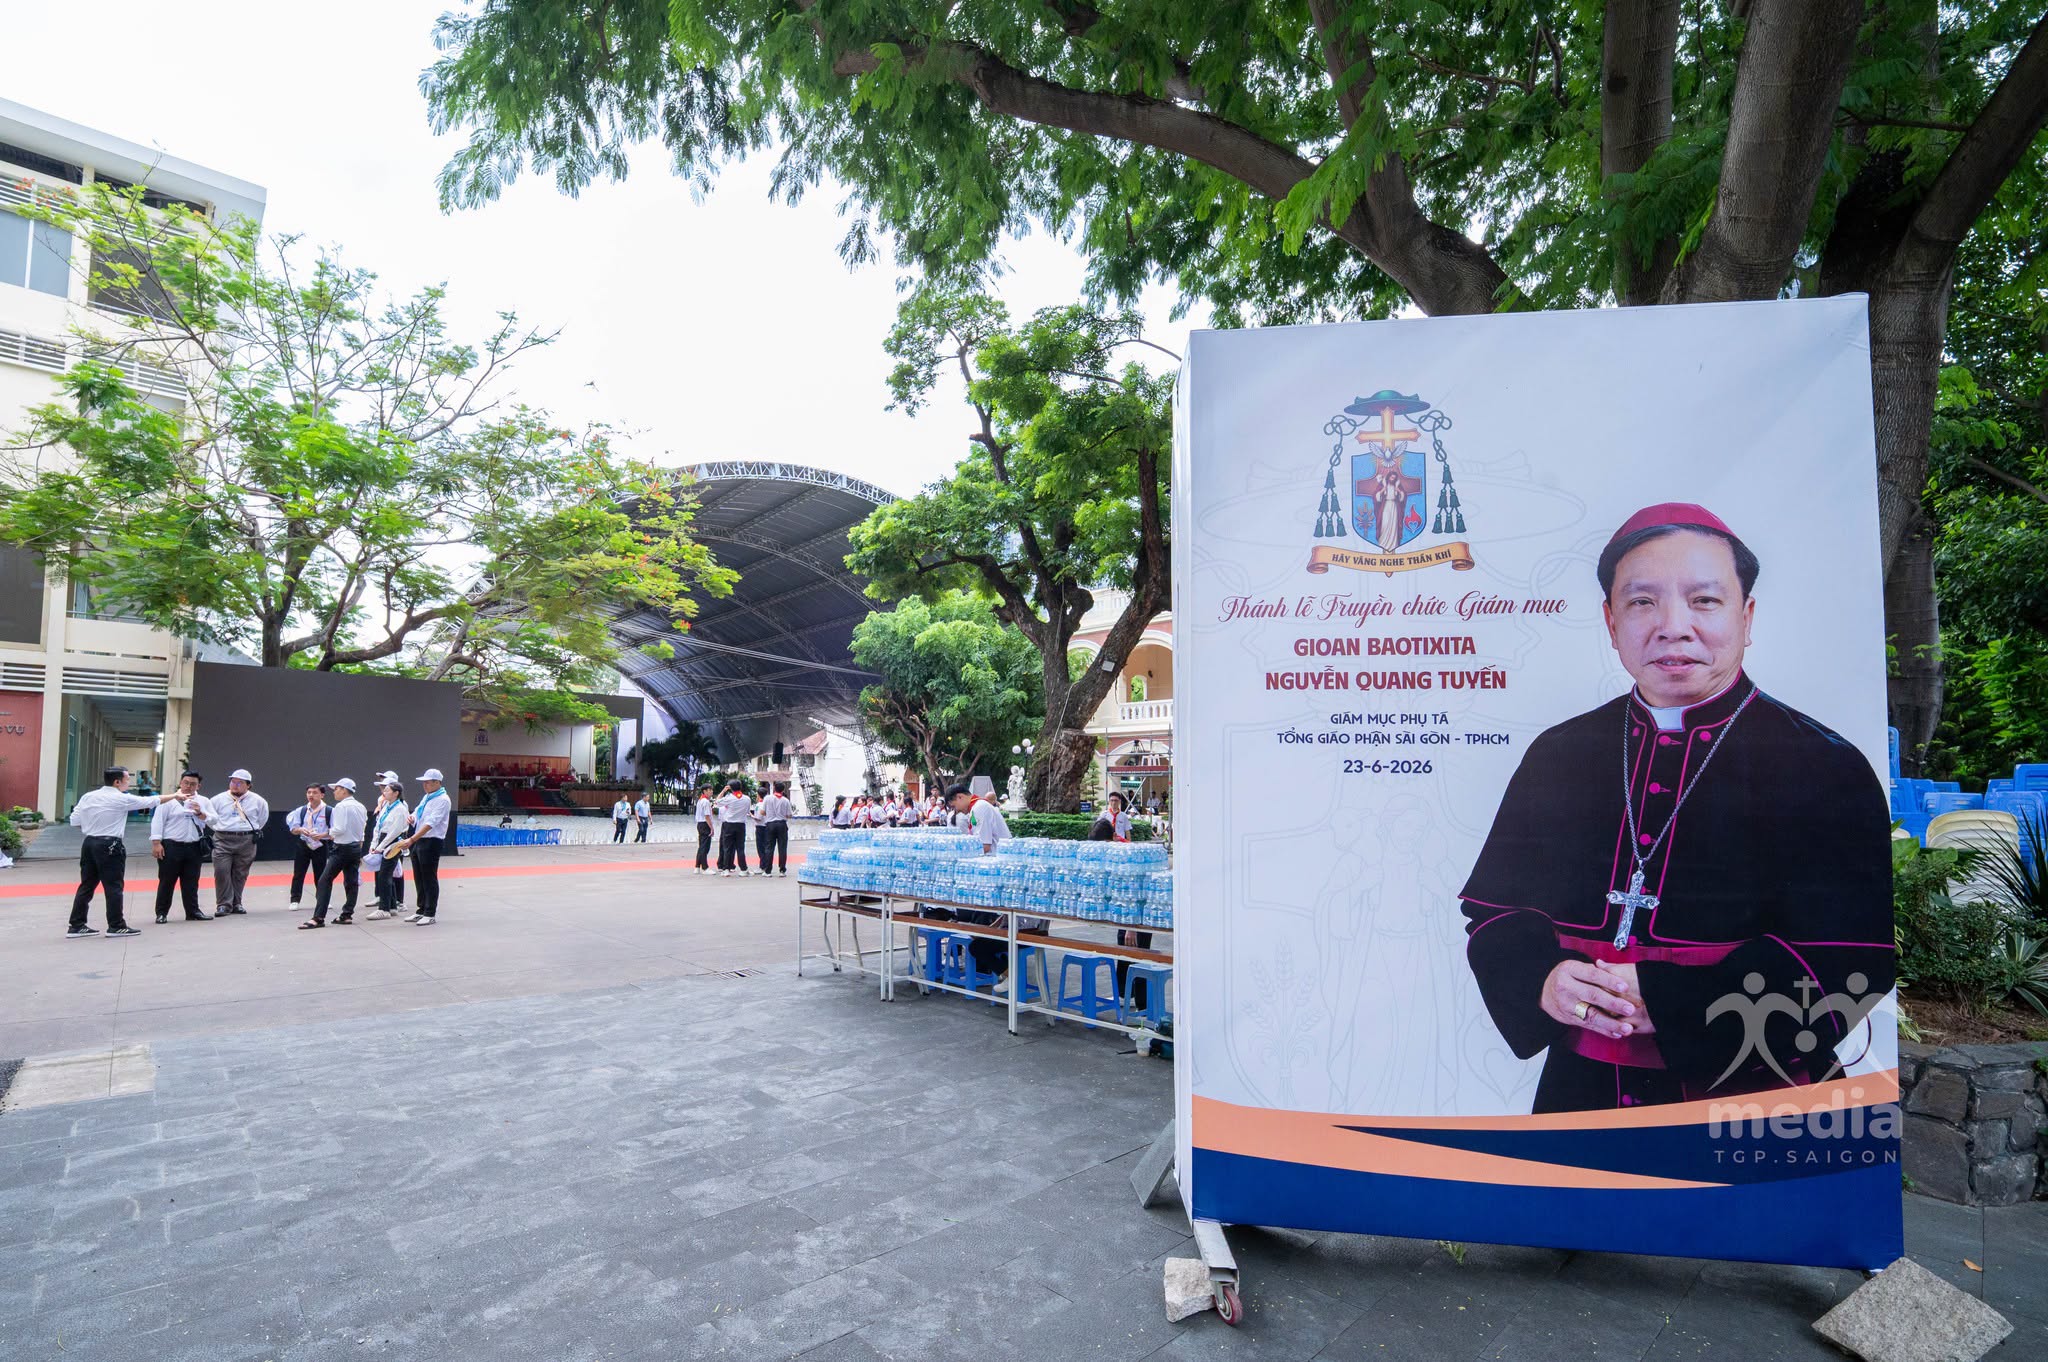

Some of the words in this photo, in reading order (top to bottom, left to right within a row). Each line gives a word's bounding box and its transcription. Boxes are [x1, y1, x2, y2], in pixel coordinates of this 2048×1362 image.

[1379, 557, 1405, 567] NGHE
[1218, 593, 1289, 623] Thánh
[1294, 595, 1317, 618] lễ
[1317, 592, 1396, 629] Truyền
[1402, 593, 1449, 616] chức
[1454, 590, 1518, 622] Giám
[1522, 599, 1568, 617] mục
[1293, 637, 1361, 657] GIOAN
[1367, 636, 1477, 656] BAOTIXITA
[1265, 665, 1349, 691] NGUYỄN
[1355, 671, 1432, 692] QUANG
[1438, 664, 1507, 690] TUYẾN
[1330, 711, 1363, 725] GIÁM
[1367, 713, 1396, 728] MỤC
[1400, 713, 1427, 728] PHỤ
[1431, 711, 1449, 725] TÁ
[1277, 726, 1314, 744] TỔNG
[1317, 730, 1351, 744] GIÁO
[1354, 730, 1391, 747] PHẬN
[1395, 730, 1416, 745] SÀI
[1419, 730, 1450, 745] GÒN
[1464, 733, 1510, 745] TPHCM
[1343, 759, 1433, 774] 23-6-2026
